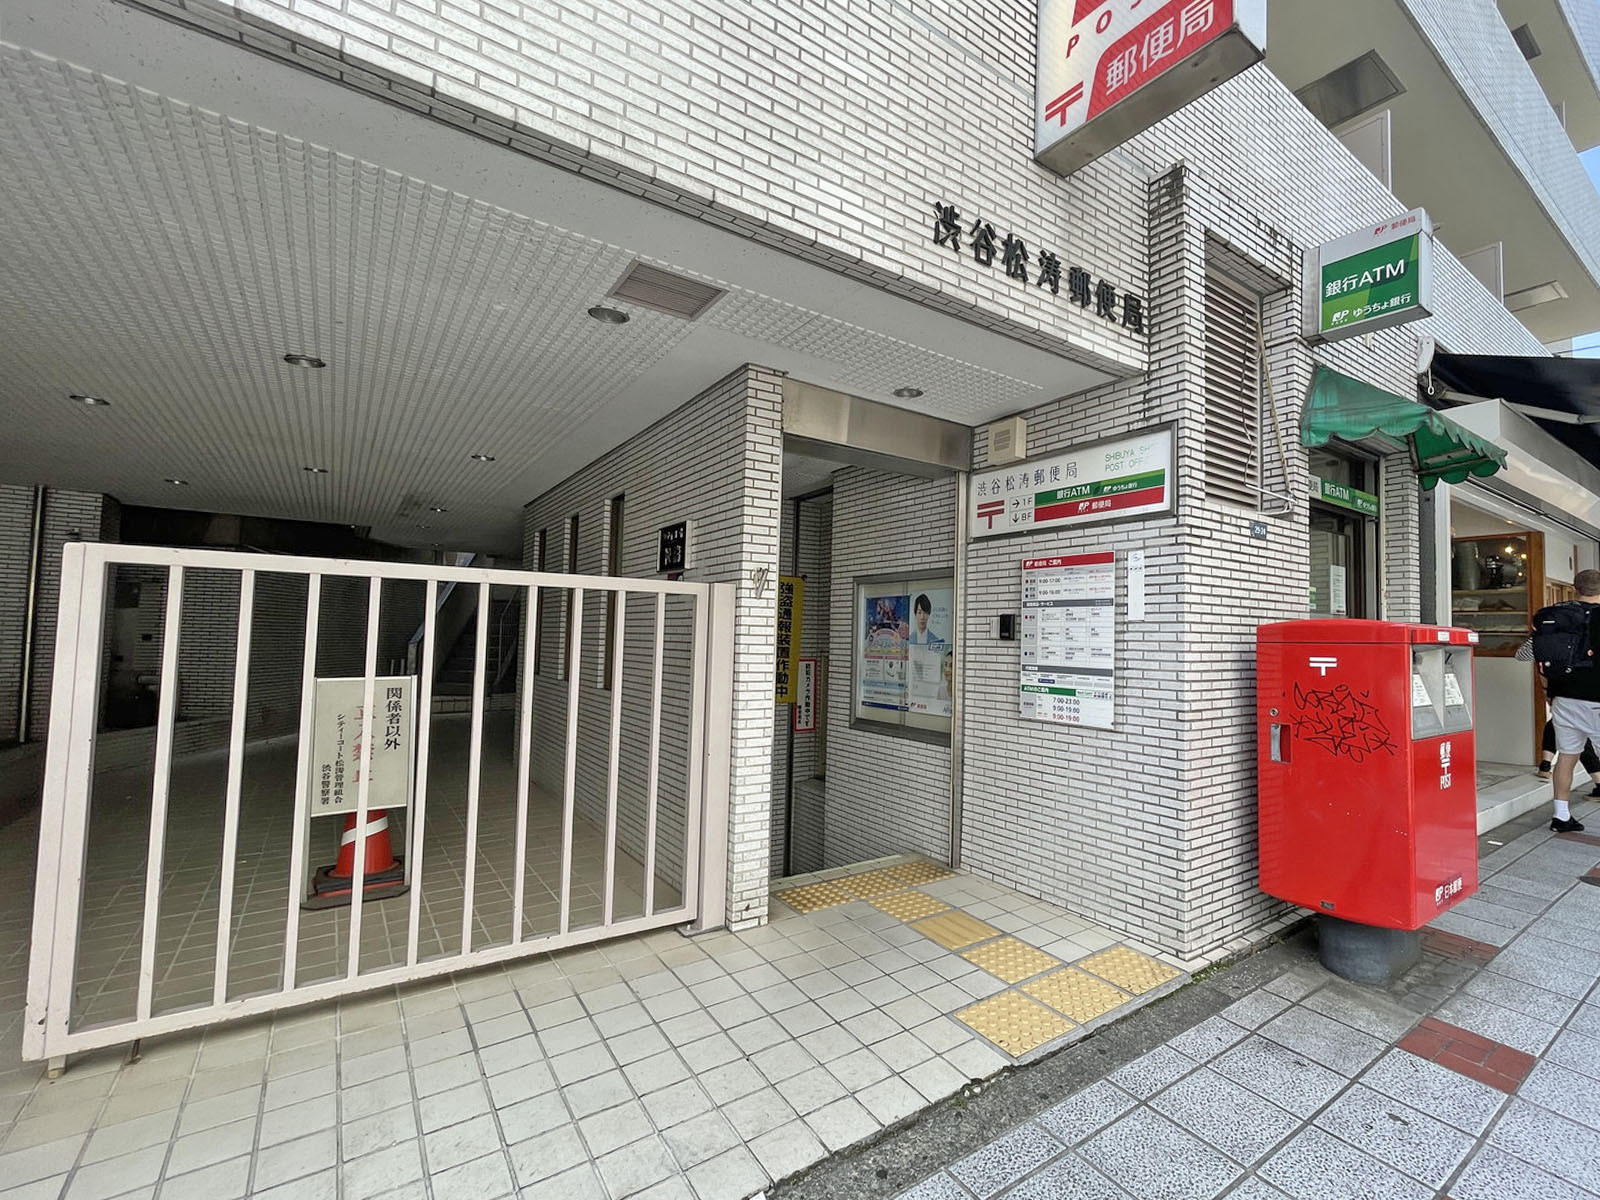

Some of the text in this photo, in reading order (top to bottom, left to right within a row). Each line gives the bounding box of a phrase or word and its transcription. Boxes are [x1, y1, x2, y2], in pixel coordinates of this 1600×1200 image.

[1106, 0, 1214, 95] 郵便局
[1391, 216, 1416, 230] 郵便局
[1325, 259, 1405, 298] 銀行ATM
[1353, 292, 1412, 318] ゆうちょ銀行
[1105, 448, 1135, 462] SHIBUYA
[1105, 461, 1124, 473] POST
[1056, 485, 1090, 500] 銀行ATM
[1112, 481, 1138, 493] ゆうちょ銀行
[1325, 482, 1350, 501] 銀行ATM
[1022, 497, 1033, 507] 1F
[1091, 499, 1112, 510] 郵便局
[384, 687, 402, 750] 関係者以外
[321, 764, 332, 805] 渋谷警察署
[1444, 876, 1463, 899] 日本郵便
